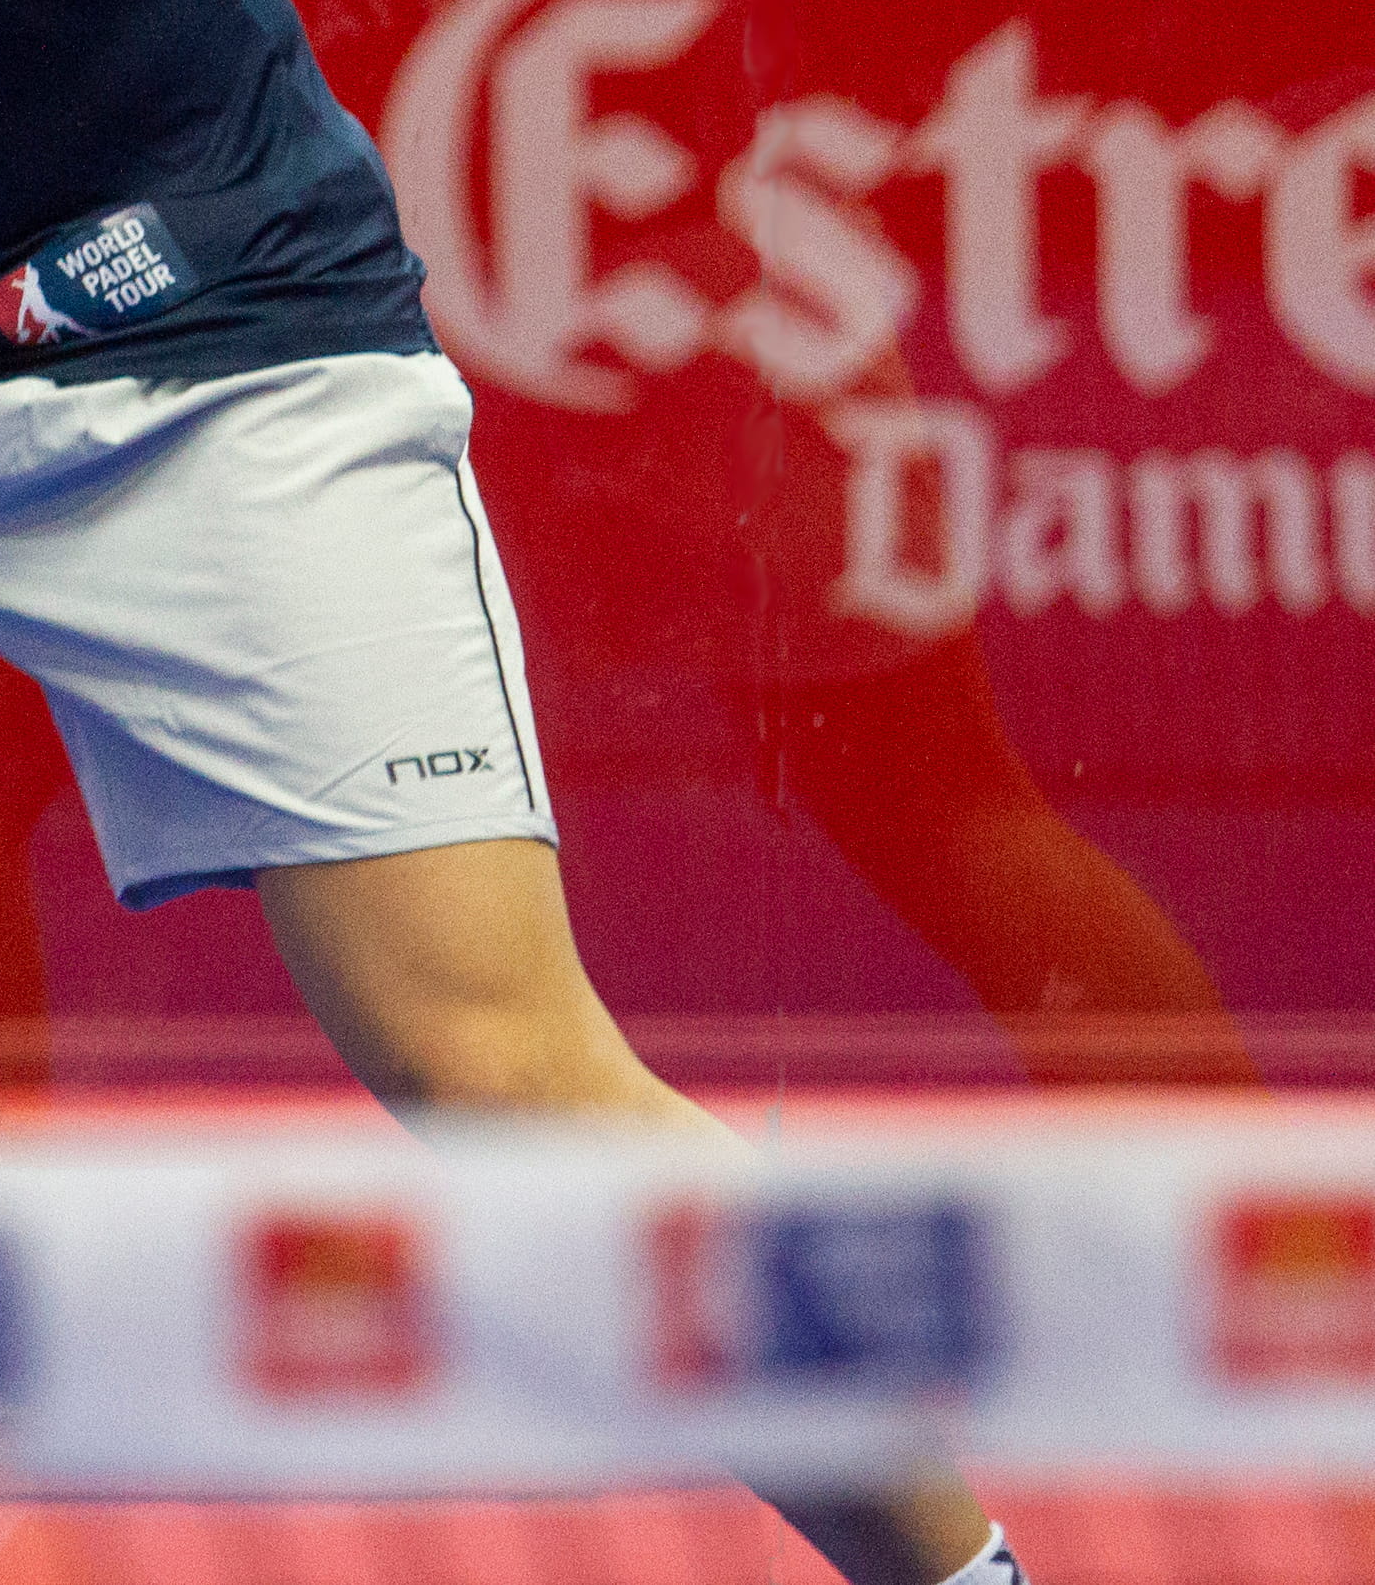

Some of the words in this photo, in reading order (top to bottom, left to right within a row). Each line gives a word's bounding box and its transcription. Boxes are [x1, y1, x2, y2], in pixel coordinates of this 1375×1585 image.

[56, 217, 145, 280] WORLD
[81, 242, 162, 298] PADEL
[104, 263, 176, 313] TOUR
[386, 748, 493, 786] nox
